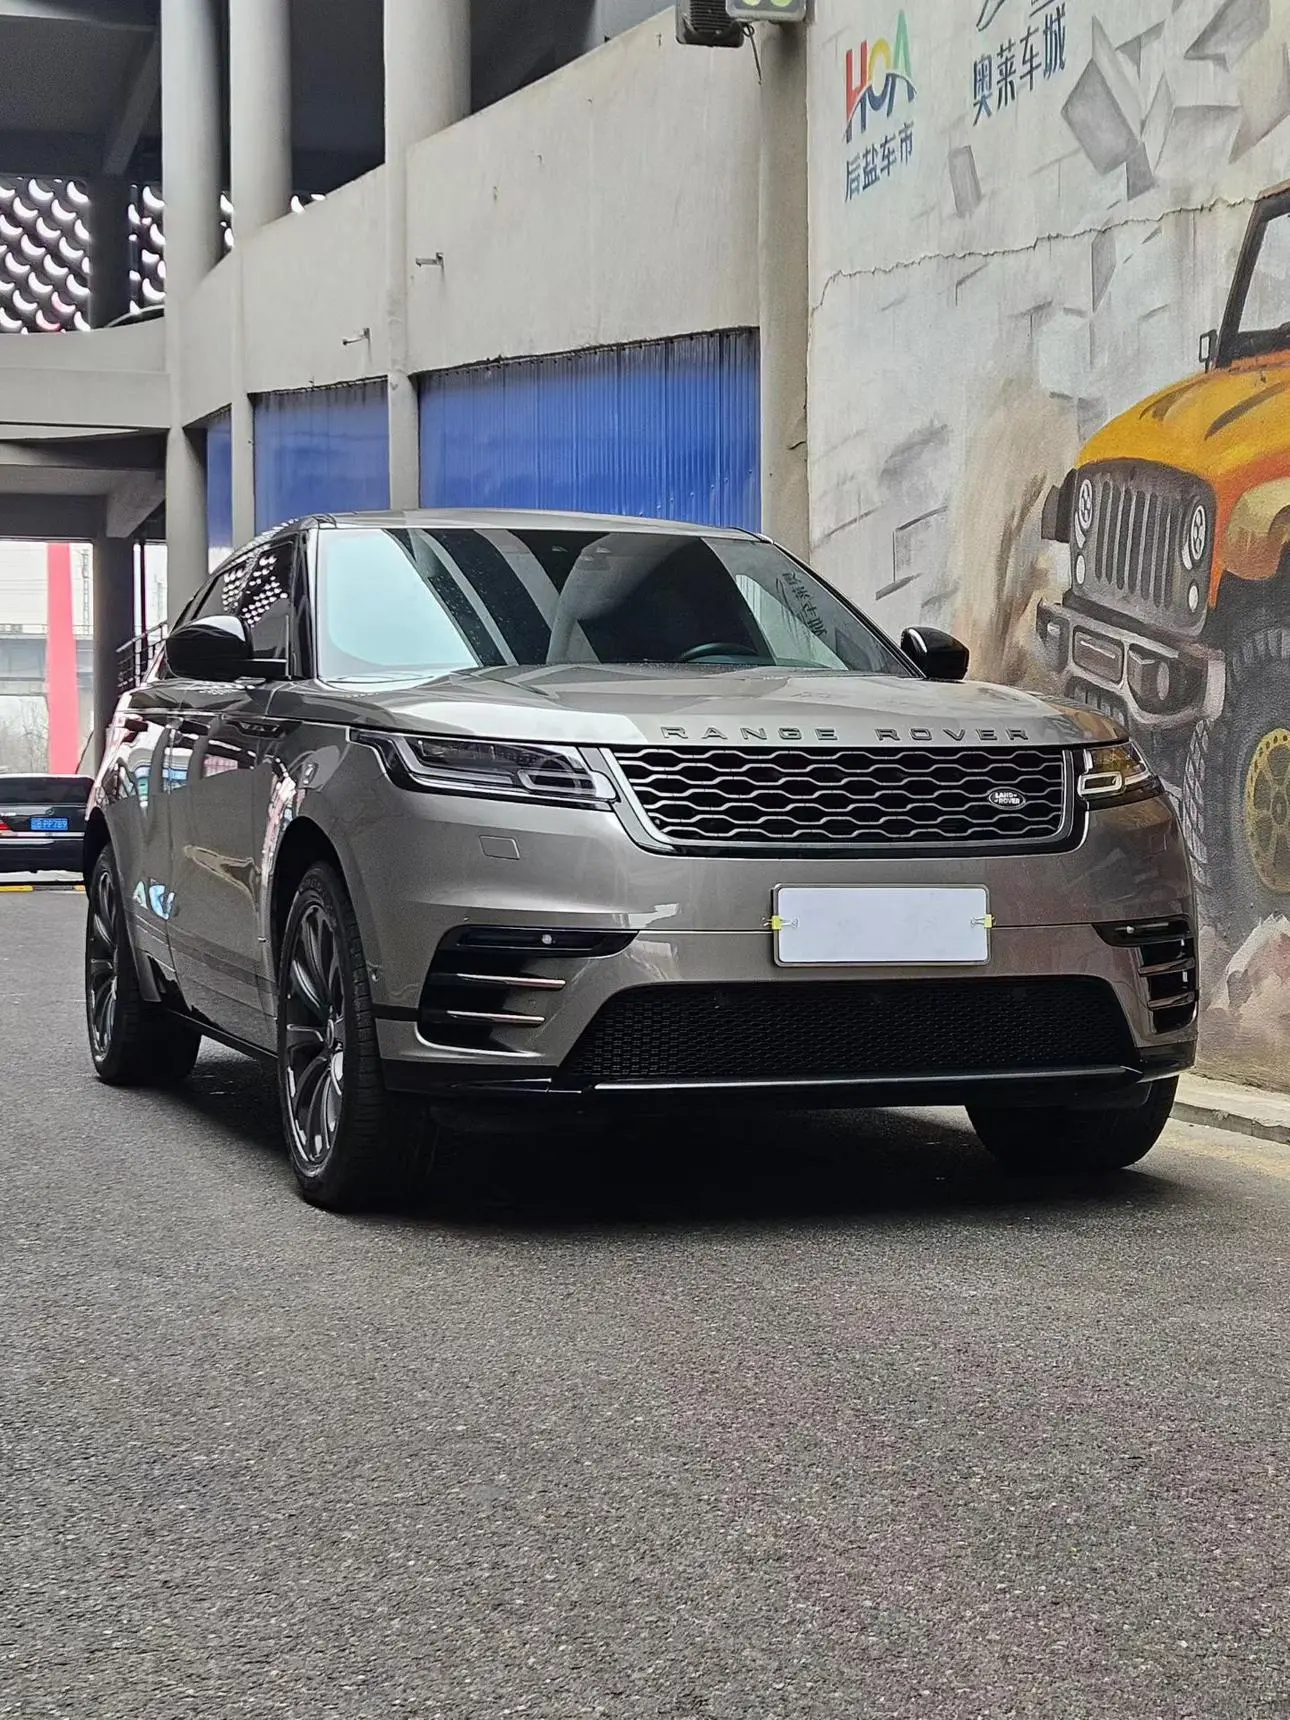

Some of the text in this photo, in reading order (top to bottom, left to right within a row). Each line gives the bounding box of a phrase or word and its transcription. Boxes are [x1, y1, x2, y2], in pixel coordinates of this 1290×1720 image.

[972, 3, 1066, 127] 奥莱车城
[845, 120, 914, 202] 后盐车市
[660, 726, 1029, 741] RANGE ROVER
